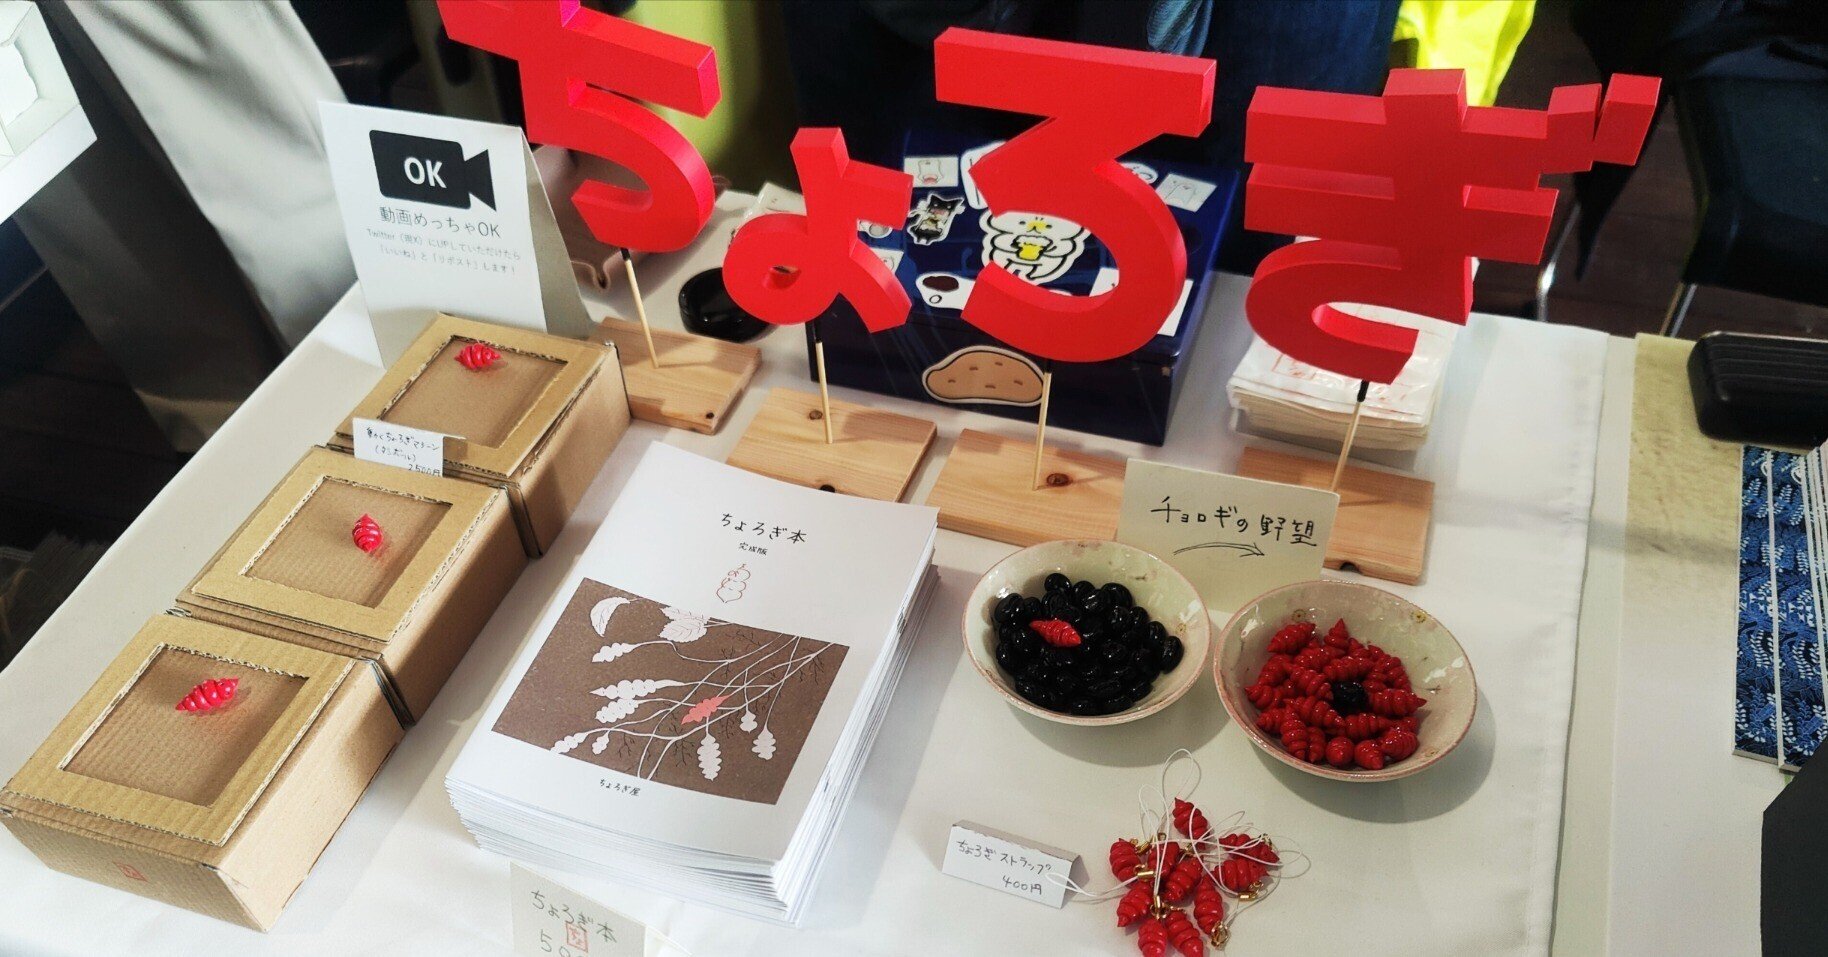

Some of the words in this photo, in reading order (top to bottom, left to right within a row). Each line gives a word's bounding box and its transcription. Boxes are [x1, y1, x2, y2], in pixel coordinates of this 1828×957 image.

[404, 156, 447, 189] OK
[379, 206, 502, 239] 動画めっちゃOK
[721, 513, 807, 544] ちょろぎ本
[1150, 496, 1318, 547] チョロギの野望
[739, 541, 768, 556] 完成版
[599, 778, 641, 797] ちょろぎ屋
[1002, 874, 1043, 896] 400円
[530, 890, 618, 943] ちょろぎ本
[540, 929, 584, 957] 50
